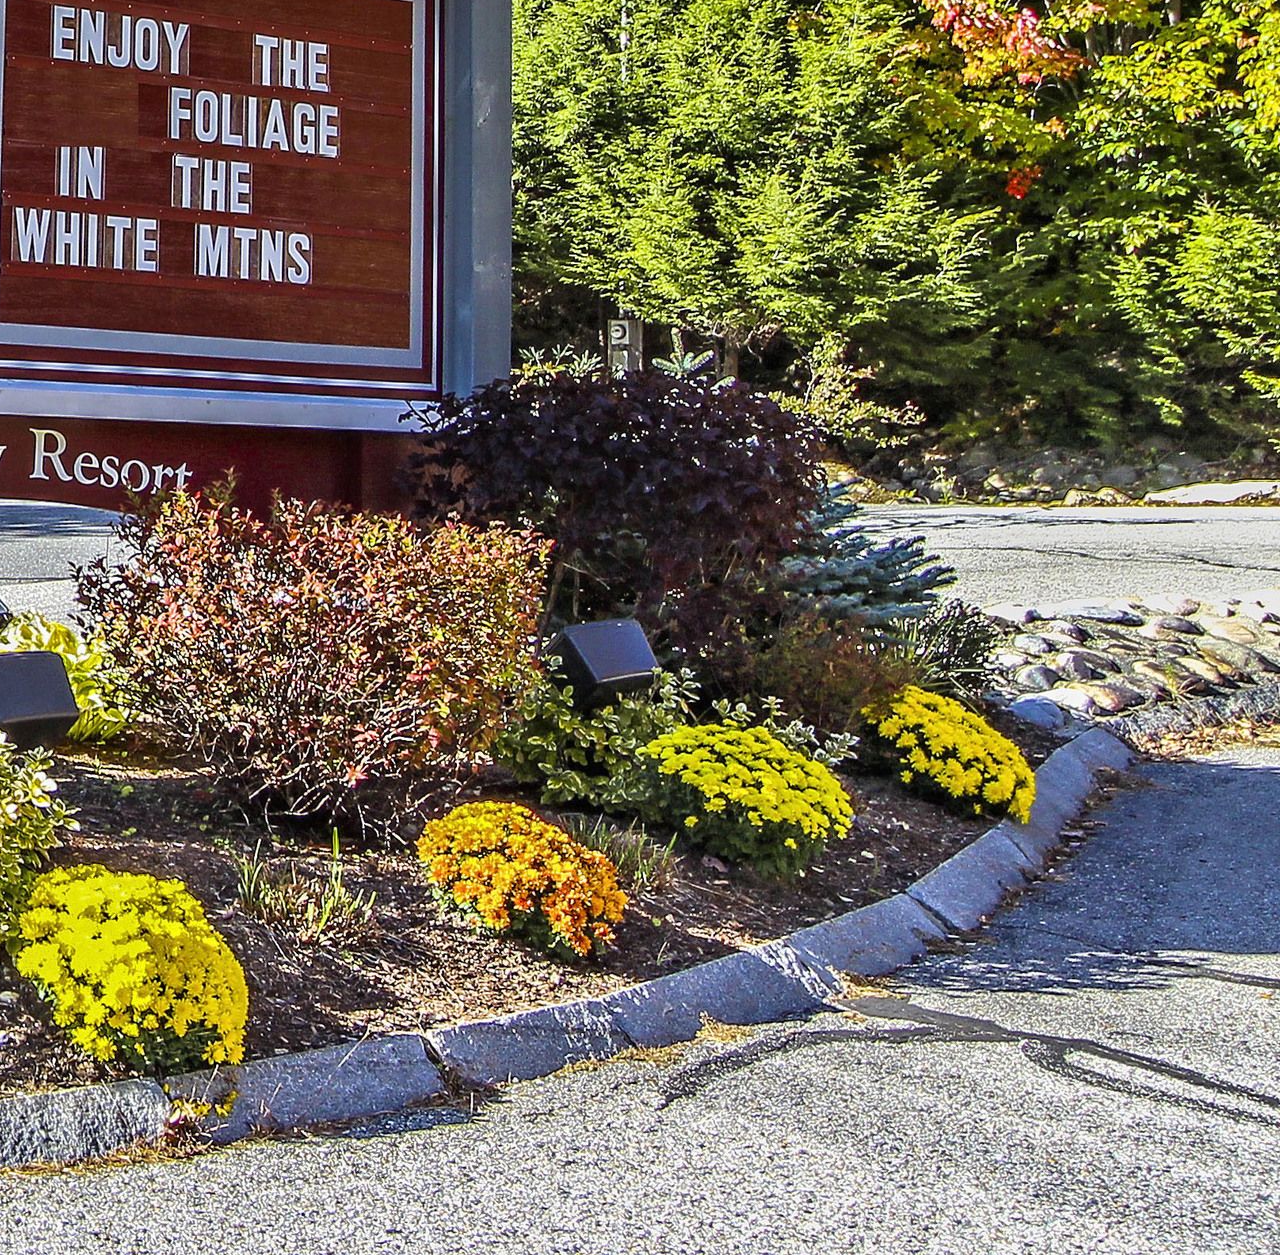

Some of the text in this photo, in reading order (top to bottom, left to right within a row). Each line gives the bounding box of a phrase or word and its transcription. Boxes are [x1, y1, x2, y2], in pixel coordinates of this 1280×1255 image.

[52, 5, 329, 92] ENJOY THE
[169, 86, 339, 158] FOLIAGE
[58, 146, 252, 214] IN THE
[14, 207, 312, 285] WHITE MTNS
[28, 427, 194, 494] Resort
